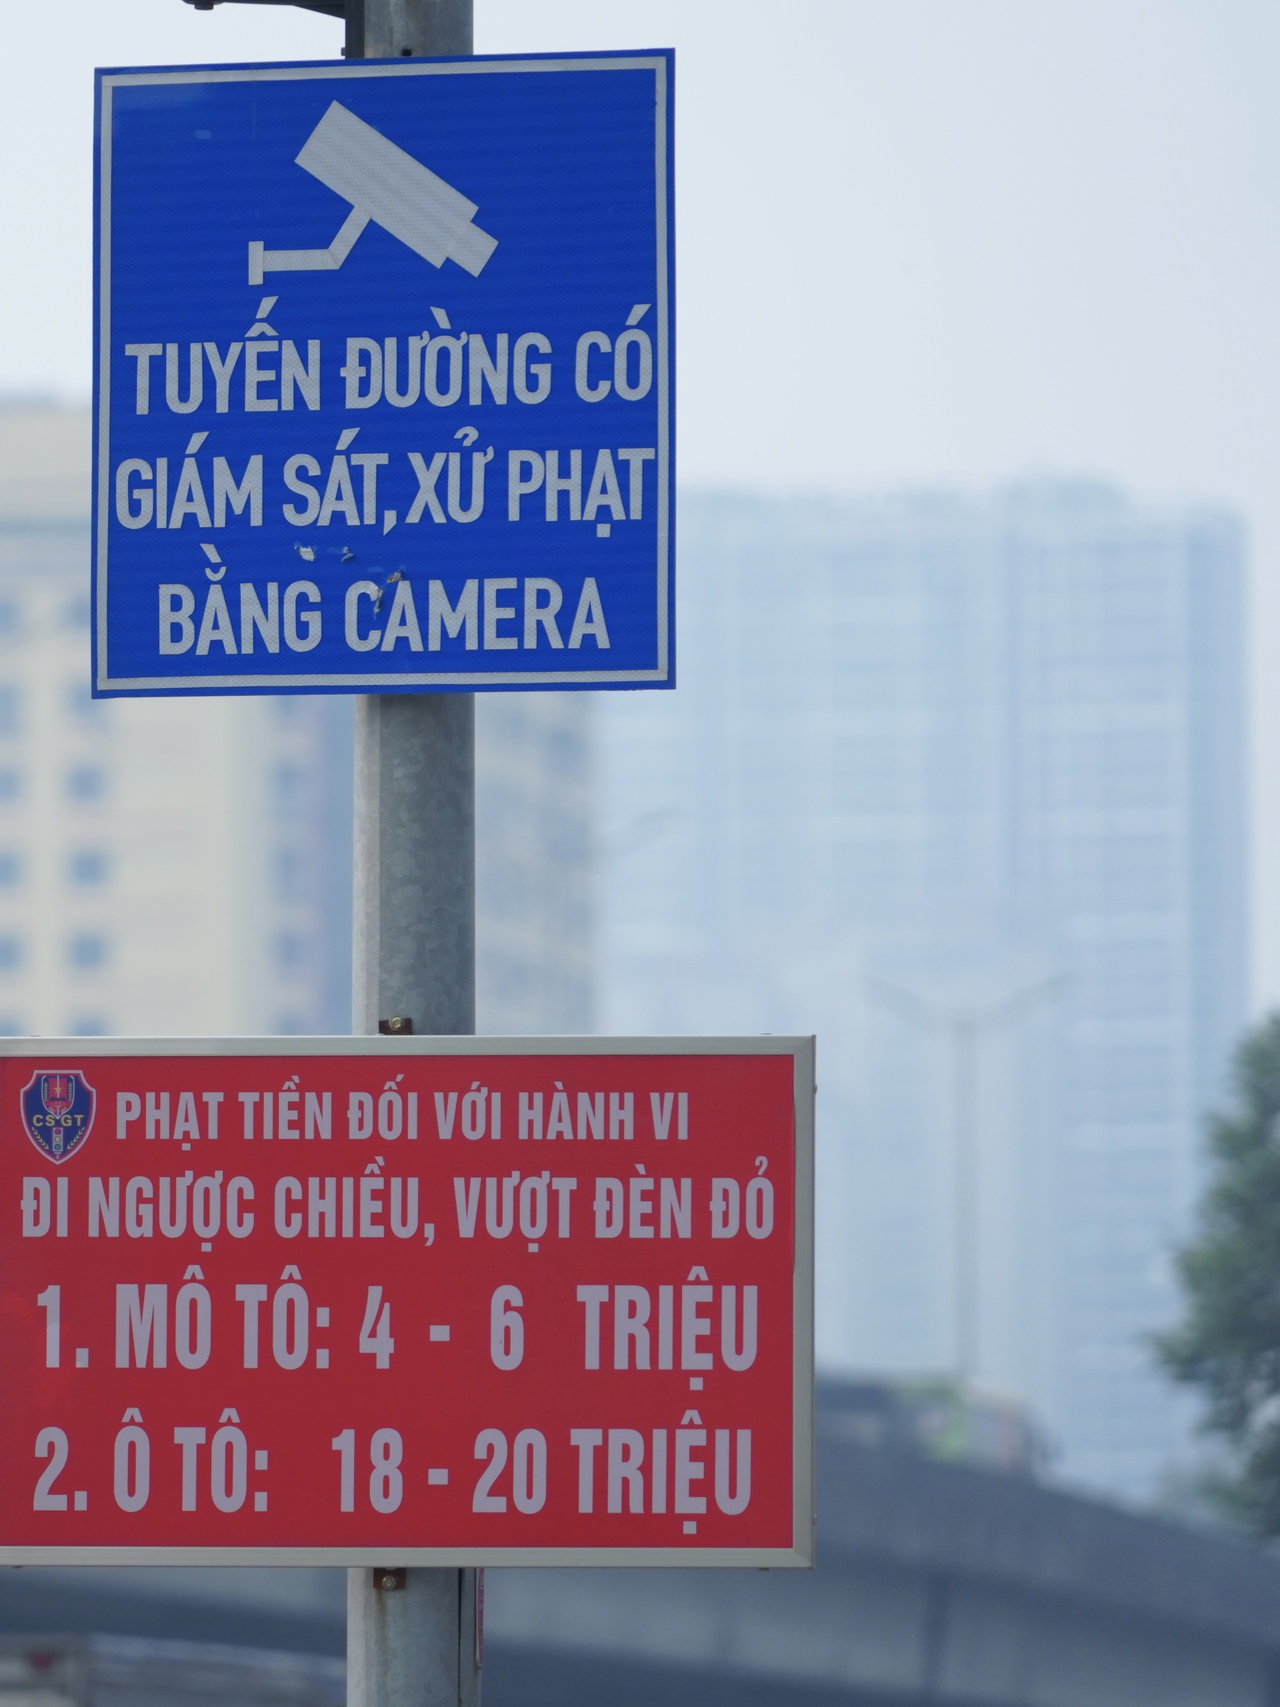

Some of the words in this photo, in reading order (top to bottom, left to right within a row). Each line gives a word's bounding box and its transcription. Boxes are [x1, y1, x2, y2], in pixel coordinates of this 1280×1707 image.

[125, 296, 320, 414] TUYẾN
[340, 307, 551, 408] ĐƯỜNG
[575, 304, 652, 402] CÓ
[116, 432, 262, 529] GIÁM
[283, 428, 396, 535] SÁT,
[405, 426, 494, 523] XỬ
[508, 448, 655, 537] PHẠT
[159, 544, 321, 655] BẰNG
[345, 577, 610, 651] CAMERA
[33, 1114, 84, 1127] CSGT
[117, 1092, 223, 1151] PHẠT
[238, 1075, 331, 1139] TIỀN
[347, 1074, 417, 1140] ĐỐI
[434, 1081, 501, 1140] VỚI
[519, 1081, 633, 1139] HÀNH
[650, 1093, 688, 1139] VI
[21, 1177, 68, 1237] ĐI
[89, 1171, 254, 1251] NGƯỢC
[275, 1156, 434, 1246] CHIỀU,
[454, 1171, 577, 1252] VƯỢT
[594, 1164, 691, 1238] ĐÈN
[710, 1156, 773, 1239] ĐỎ
[38, 1285, 88, 1368] 1.
[116, 1265, 211, 1369] MÔ
[236, 1265, 329, 1369] TÔ:
[360, 1286, 394, 1368] 4
[430, 1325, 450, 1341] -
[491, 1285, 523, 1370] 6
[577, 1266, 757, 1390] TRIỆU
[34, 1427, 87, 1510] 2.
[114, 1408, 149, 1512] Ô
[174, 1408, 267, 1512] TÔ:
[332, 1428, 402, 1513] 18
[428, 1469, 448, 1484] -
[473, 1429, 546, 1514] 20
[571, 1410, 751, 1534] TRIỆU
